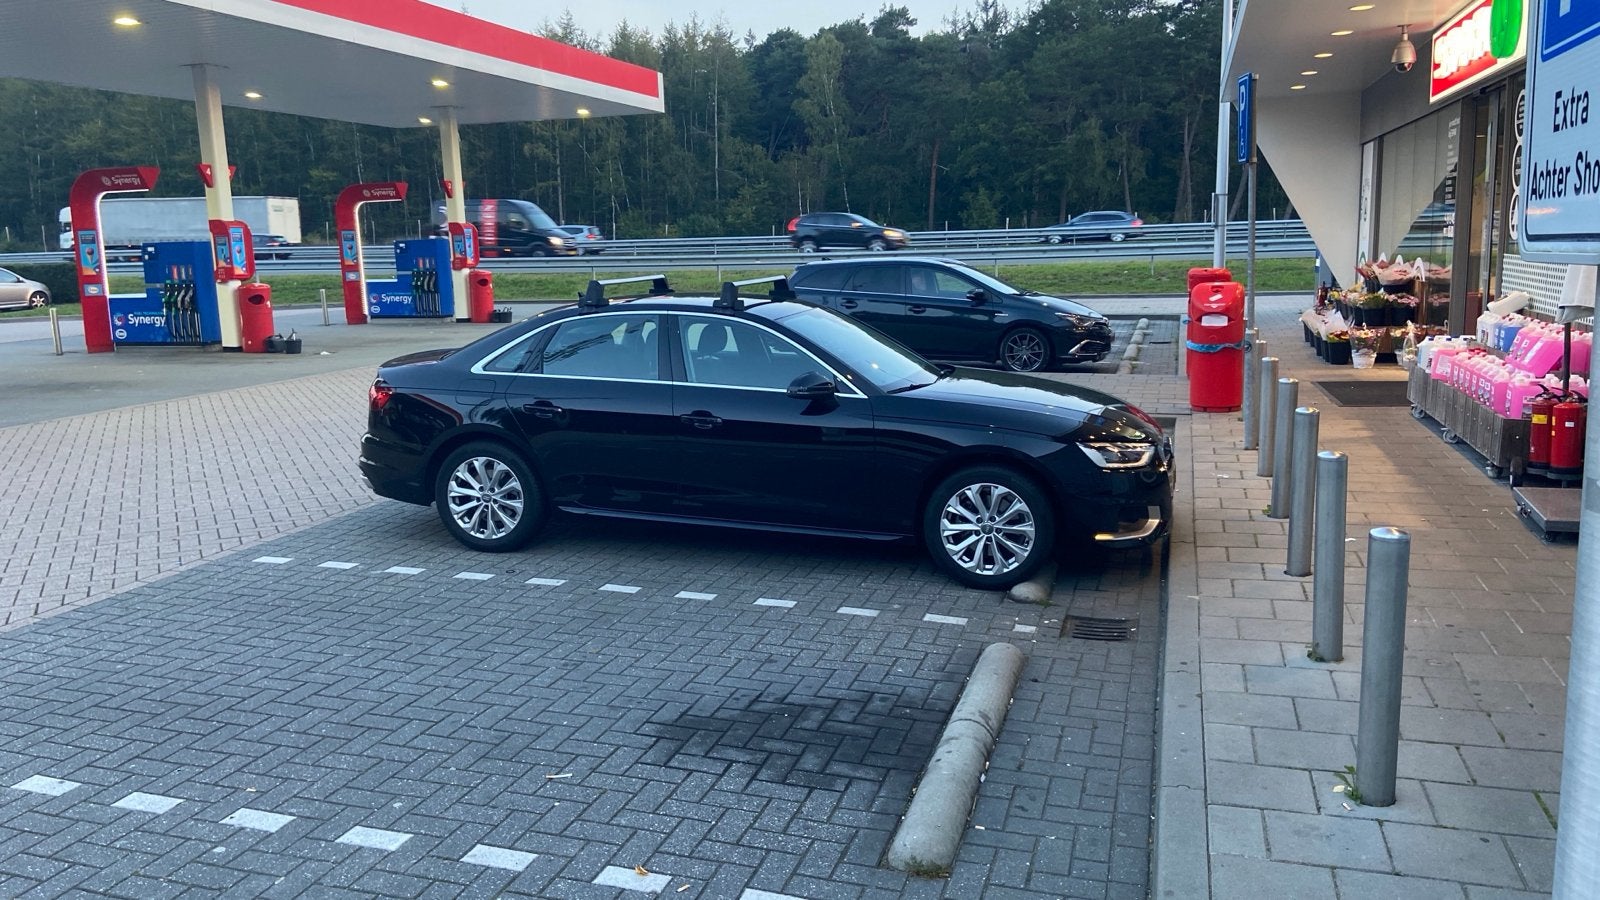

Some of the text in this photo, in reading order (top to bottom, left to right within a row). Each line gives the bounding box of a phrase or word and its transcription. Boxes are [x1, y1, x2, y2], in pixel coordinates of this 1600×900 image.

[1553, 86, 1589, 132] Extra
[111, 176, 141, 186] Synergy
[1529, 150, 1600, 201] Achter Sho
[371, 189, 396, 197] Synergy
[381, 294, 412, 304] Synergy
[128, 314, 166, 327] Synergy
